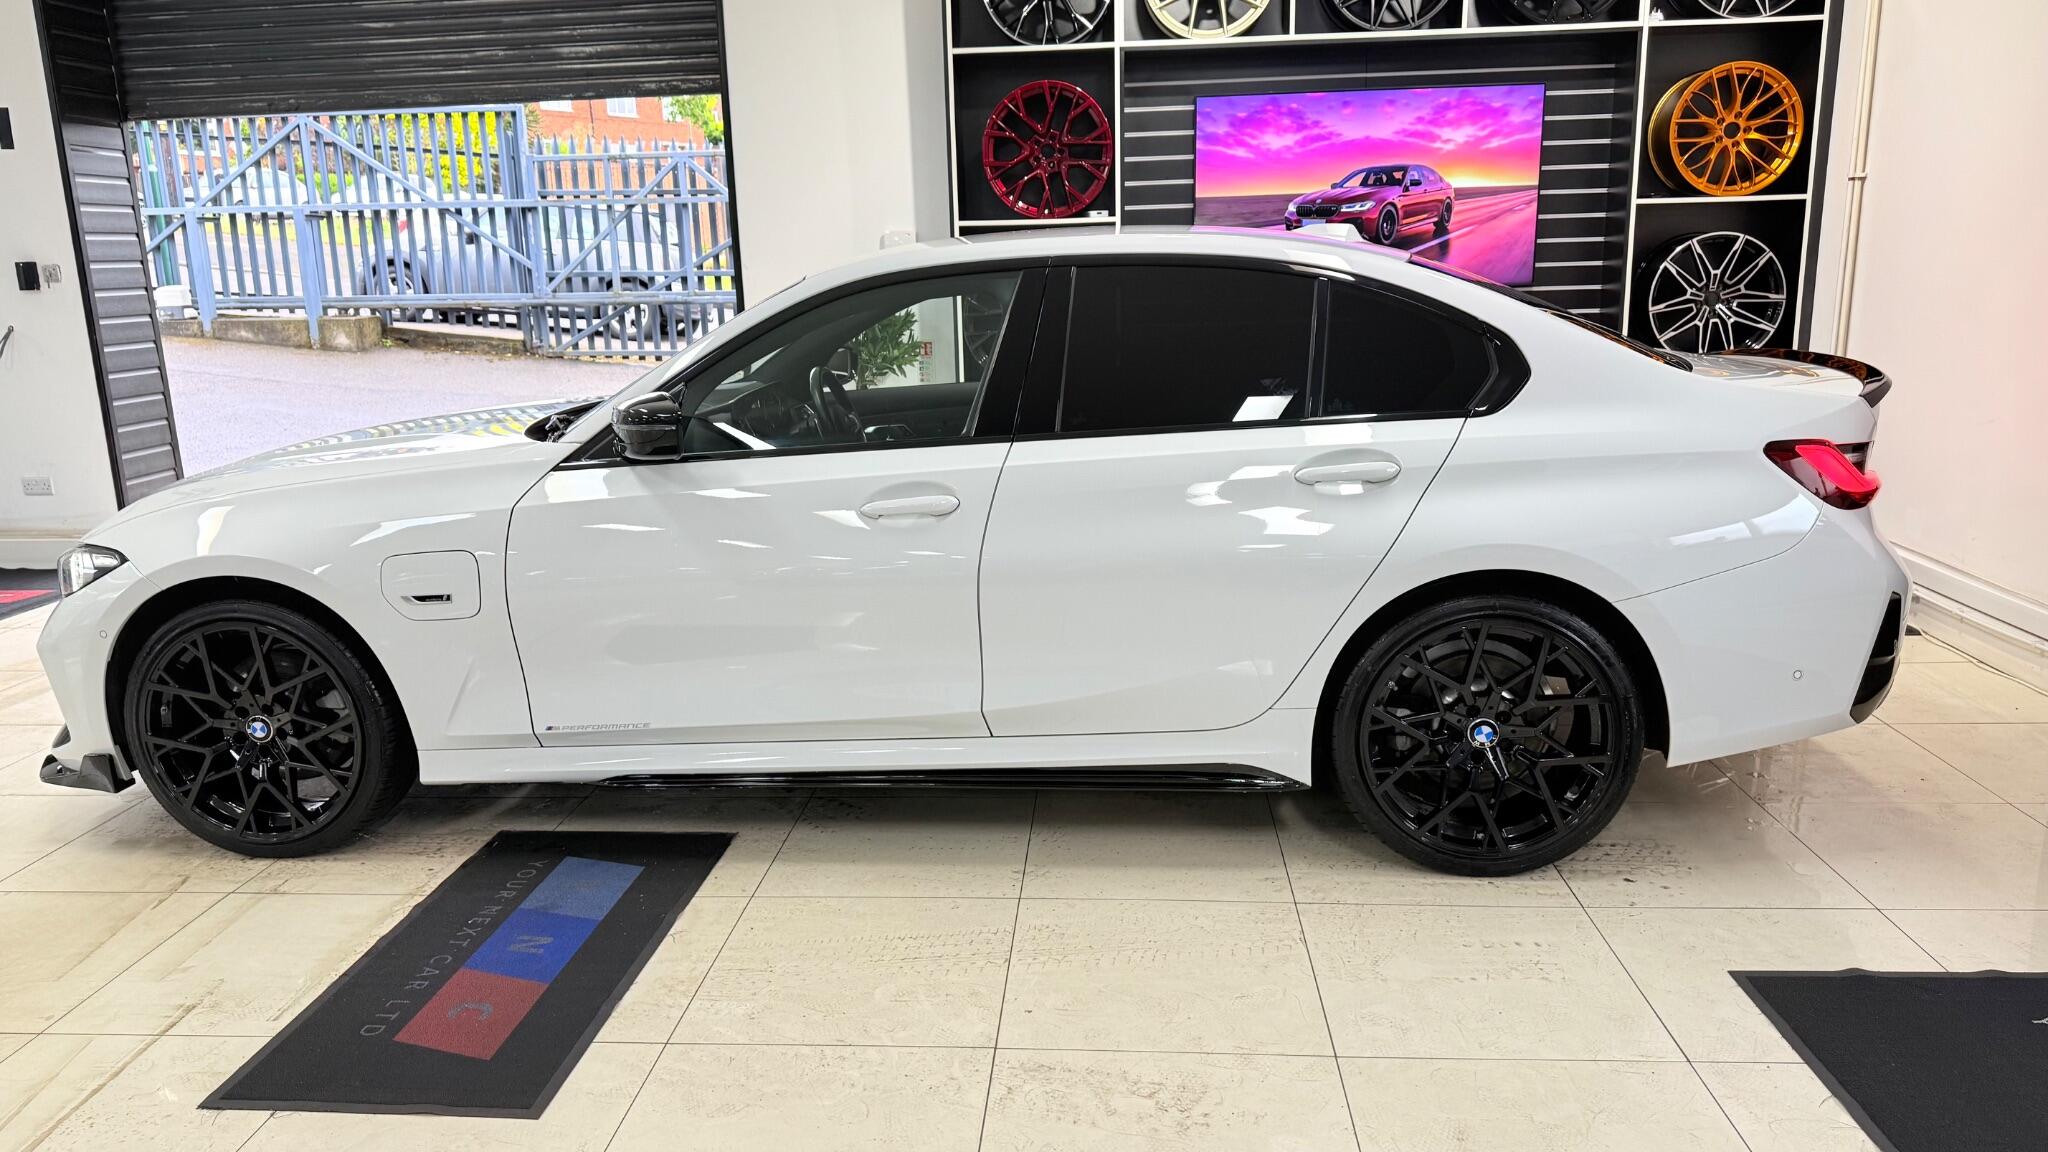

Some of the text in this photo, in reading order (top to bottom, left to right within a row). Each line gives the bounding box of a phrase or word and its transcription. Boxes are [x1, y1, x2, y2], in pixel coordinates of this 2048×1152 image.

[561, 722, 651, 731] PERFORMANCE
[360, 860, 549, 1036] YOUR NEXT CAR LTD
